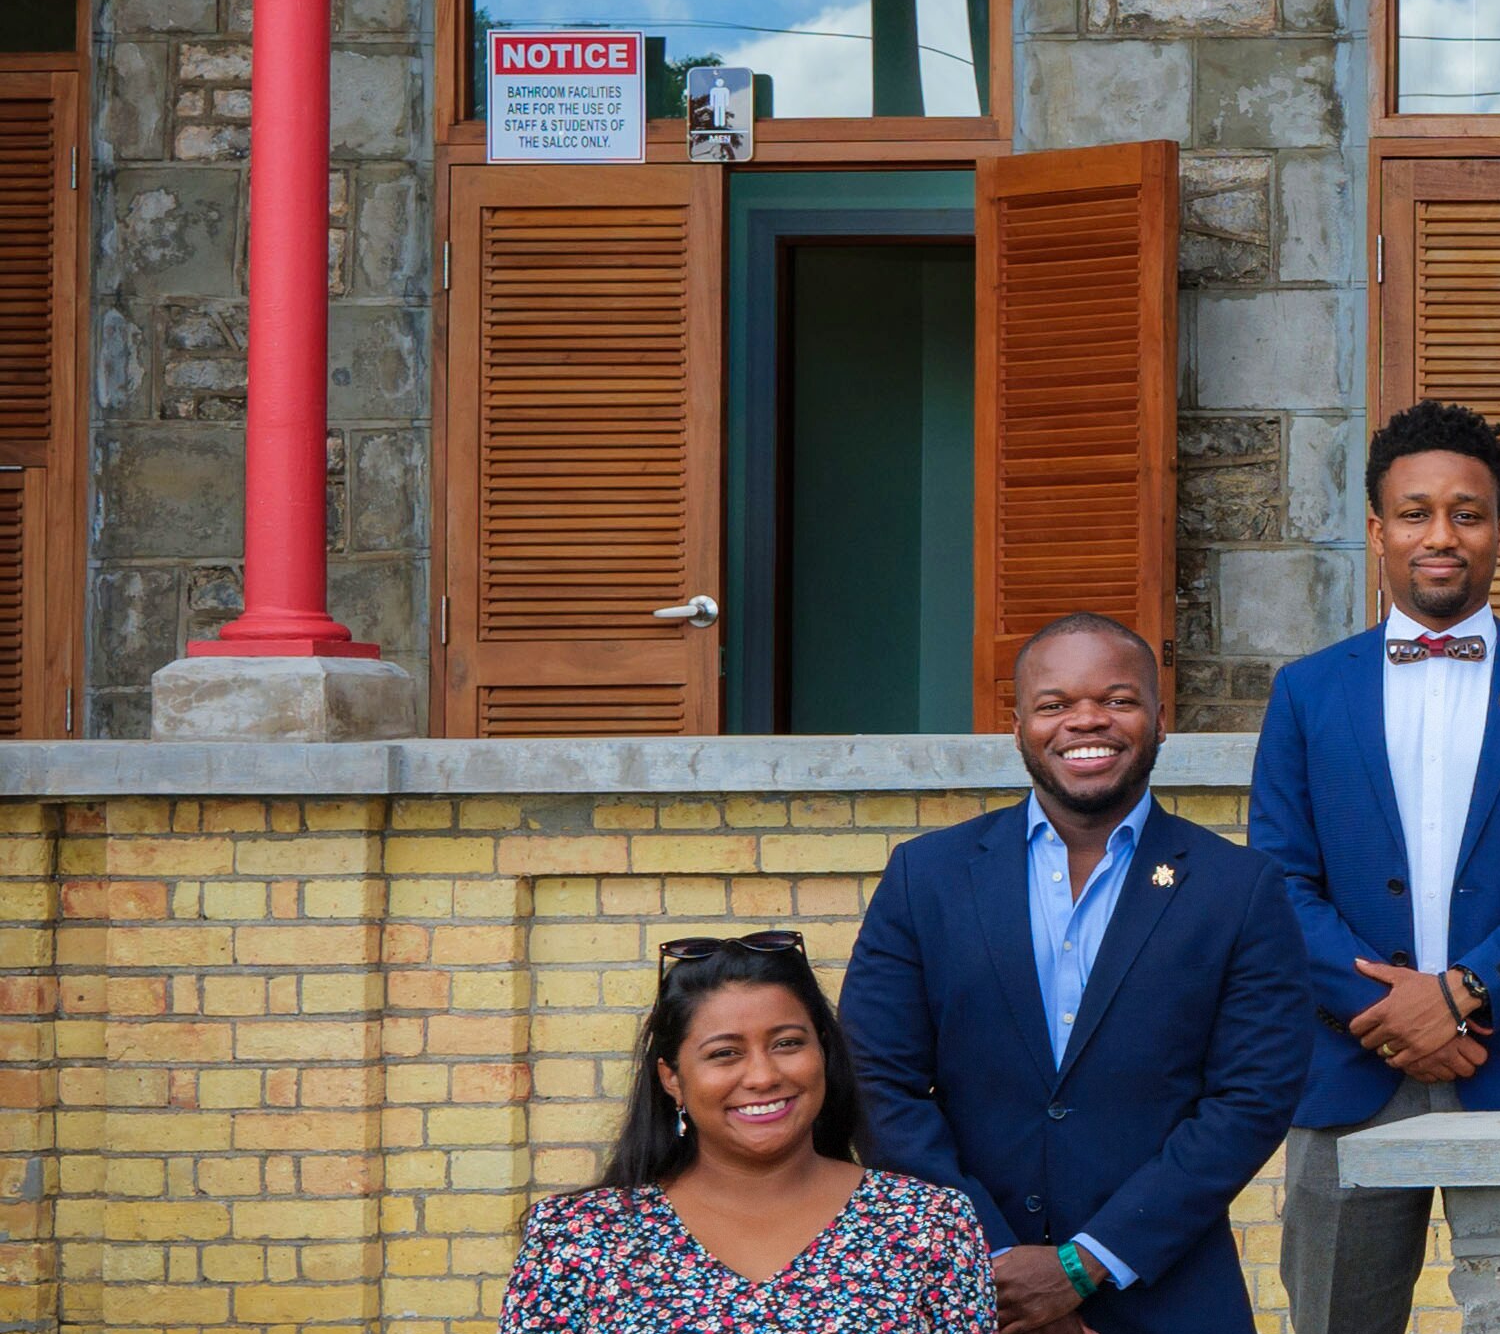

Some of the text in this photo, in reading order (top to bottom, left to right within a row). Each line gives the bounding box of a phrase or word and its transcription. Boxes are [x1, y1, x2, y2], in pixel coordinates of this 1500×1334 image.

[503, 43, 628, 69] NOTICE
[507, 87, 621, 98] BATHROOM FACILITIES
[507, 103, 622, 115] ARE FOR THE USE OF
[505, 119, 624, 131] STAFF & STUDENTS OF
[519, 136, 610, 148] THE SALCC ONLY.
